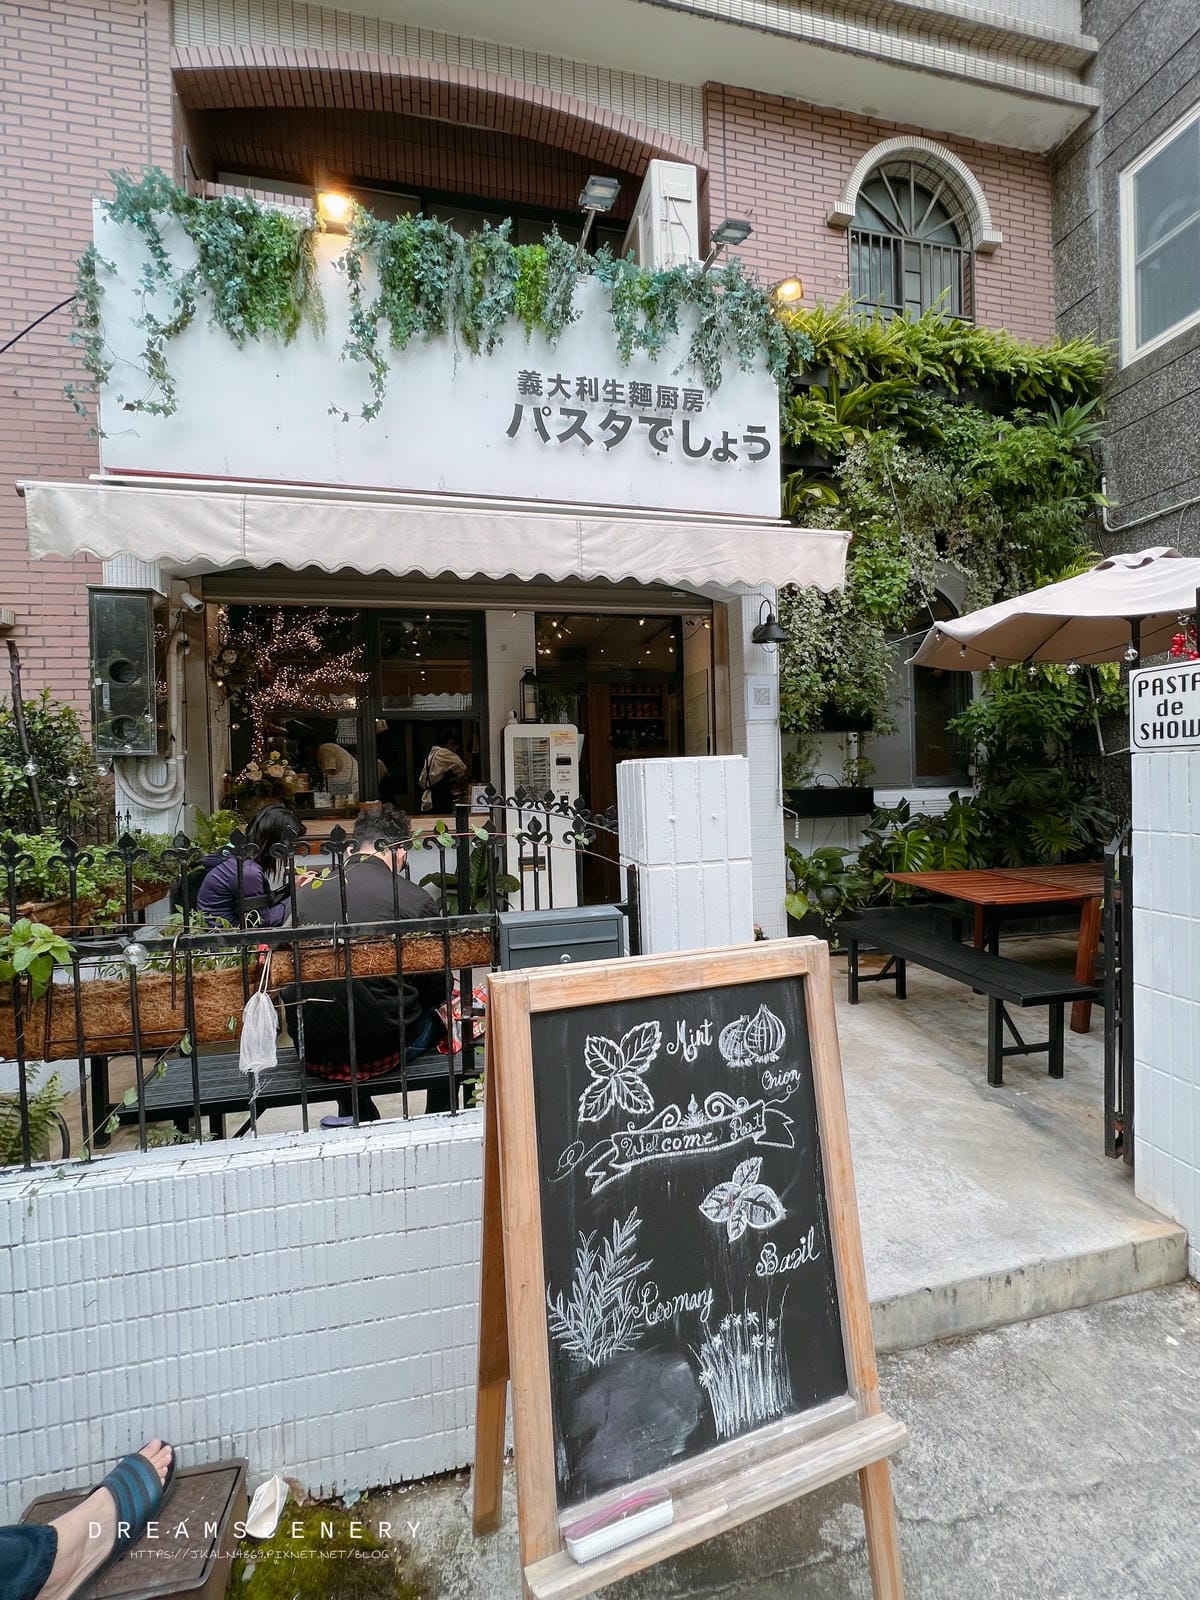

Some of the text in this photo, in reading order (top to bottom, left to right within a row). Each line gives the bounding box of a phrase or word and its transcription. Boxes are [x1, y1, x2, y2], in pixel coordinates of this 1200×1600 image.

[505, 403, 771, 462] パスタでしょう
[1156, 698, 1184, 717] de
[666, 1018, 713, 1062] Mint
[620, 1132, 718, 1158] Welcome
[755, 1225, 821, 1277] Basil
